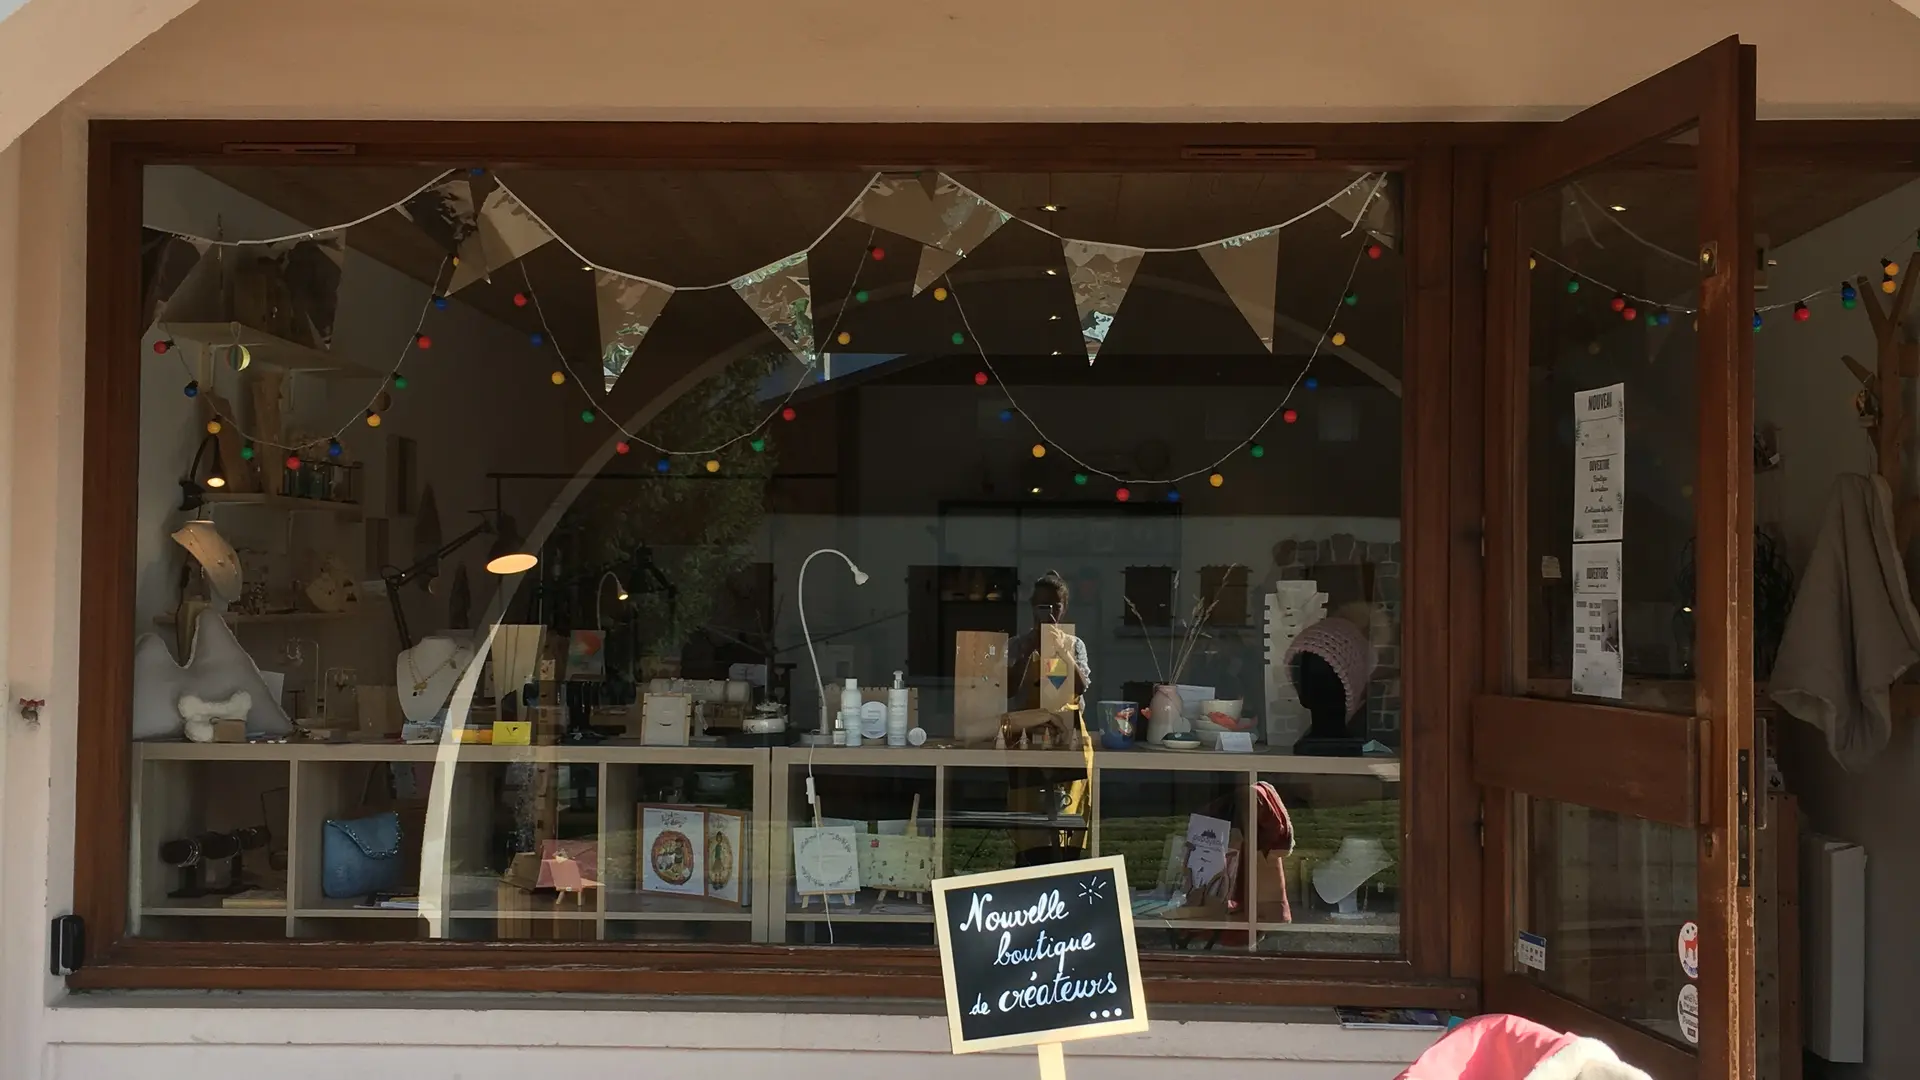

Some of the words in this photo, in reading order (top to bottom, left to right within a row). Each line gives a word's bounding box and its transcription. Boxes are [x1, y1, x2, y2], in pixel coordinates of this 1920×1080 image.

[960, 889, 1069, 932] Nouvelle
[993, 930, 1096, 973] boutique
[969, 993, 991, 1016] de
[998, 971, 1118, 1012] créateurs
